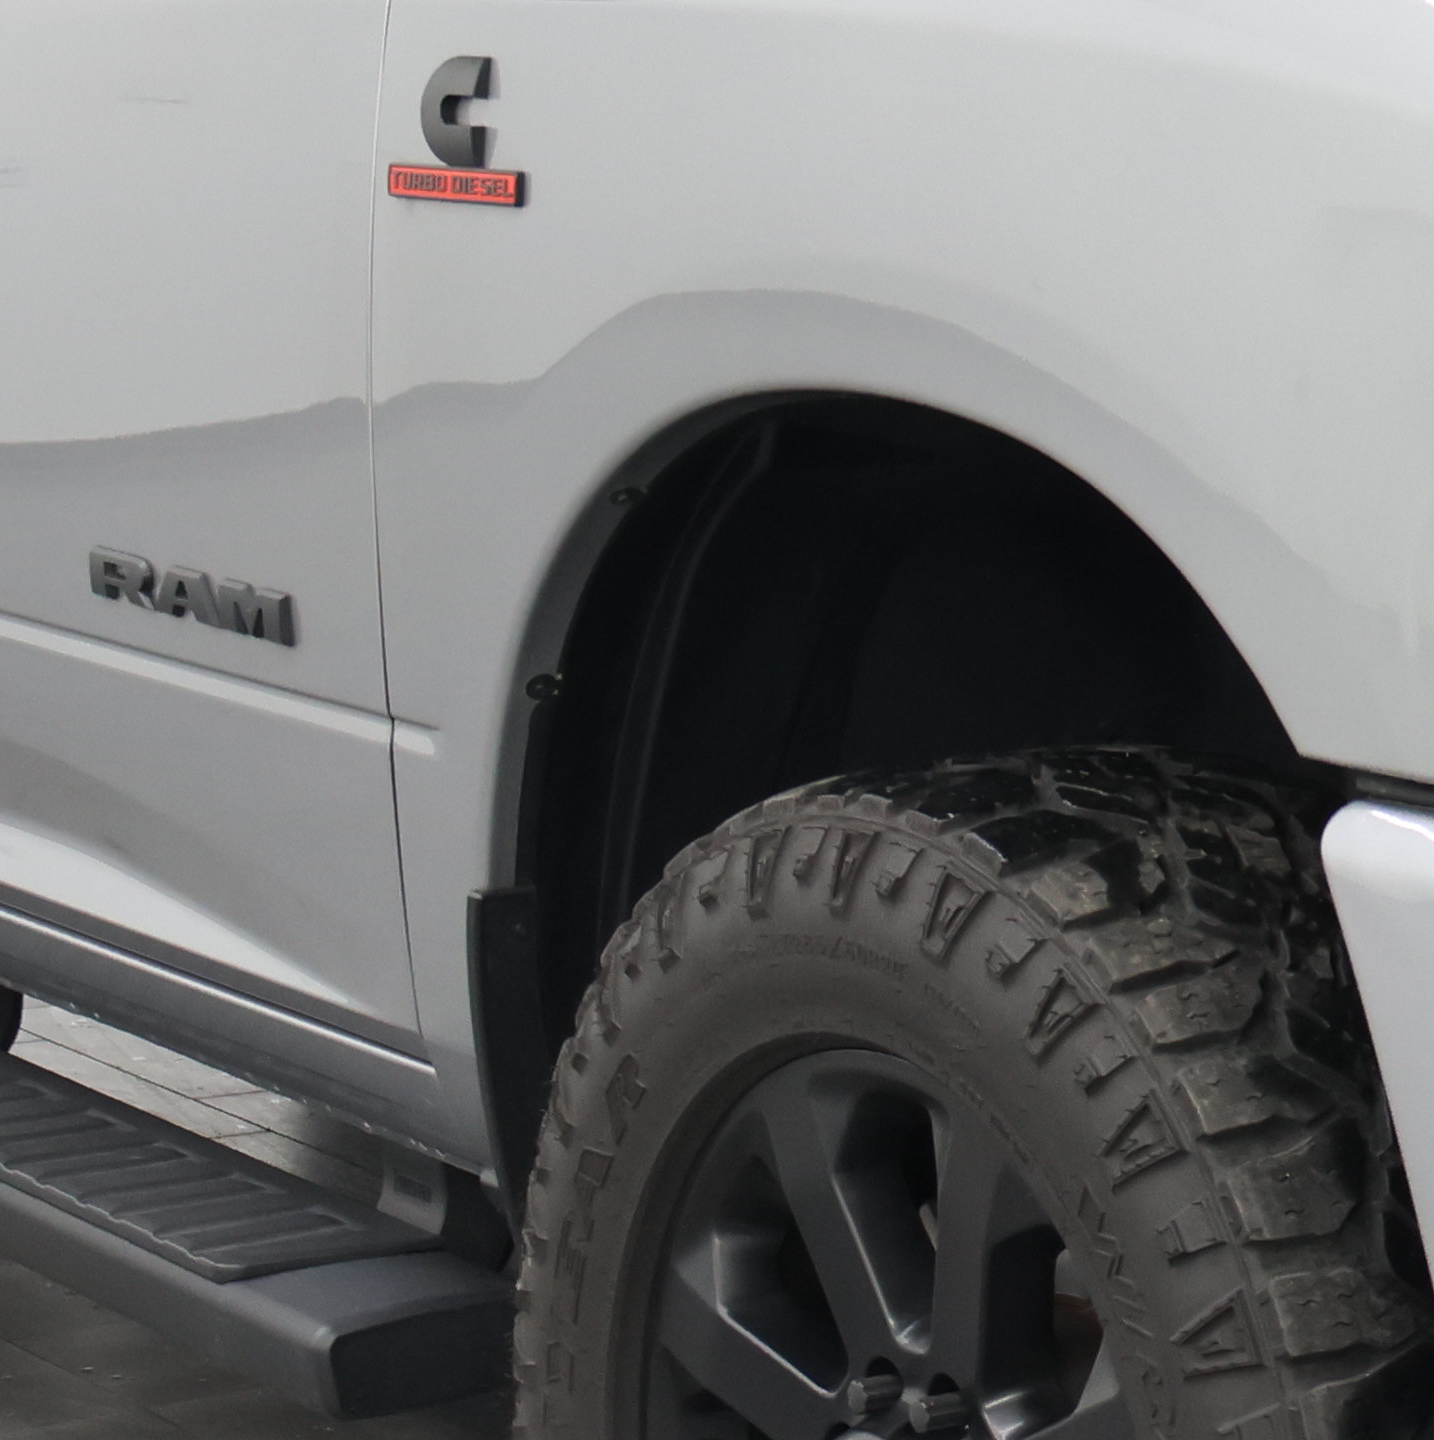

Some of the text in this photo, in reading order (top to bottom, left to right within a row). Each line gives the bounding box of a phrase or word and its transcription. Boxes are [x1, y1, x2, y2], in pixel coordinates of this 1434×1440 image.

[392, 171, 514, 197] TURBO DIESEL
[89, 545, 295, 647] RAM
